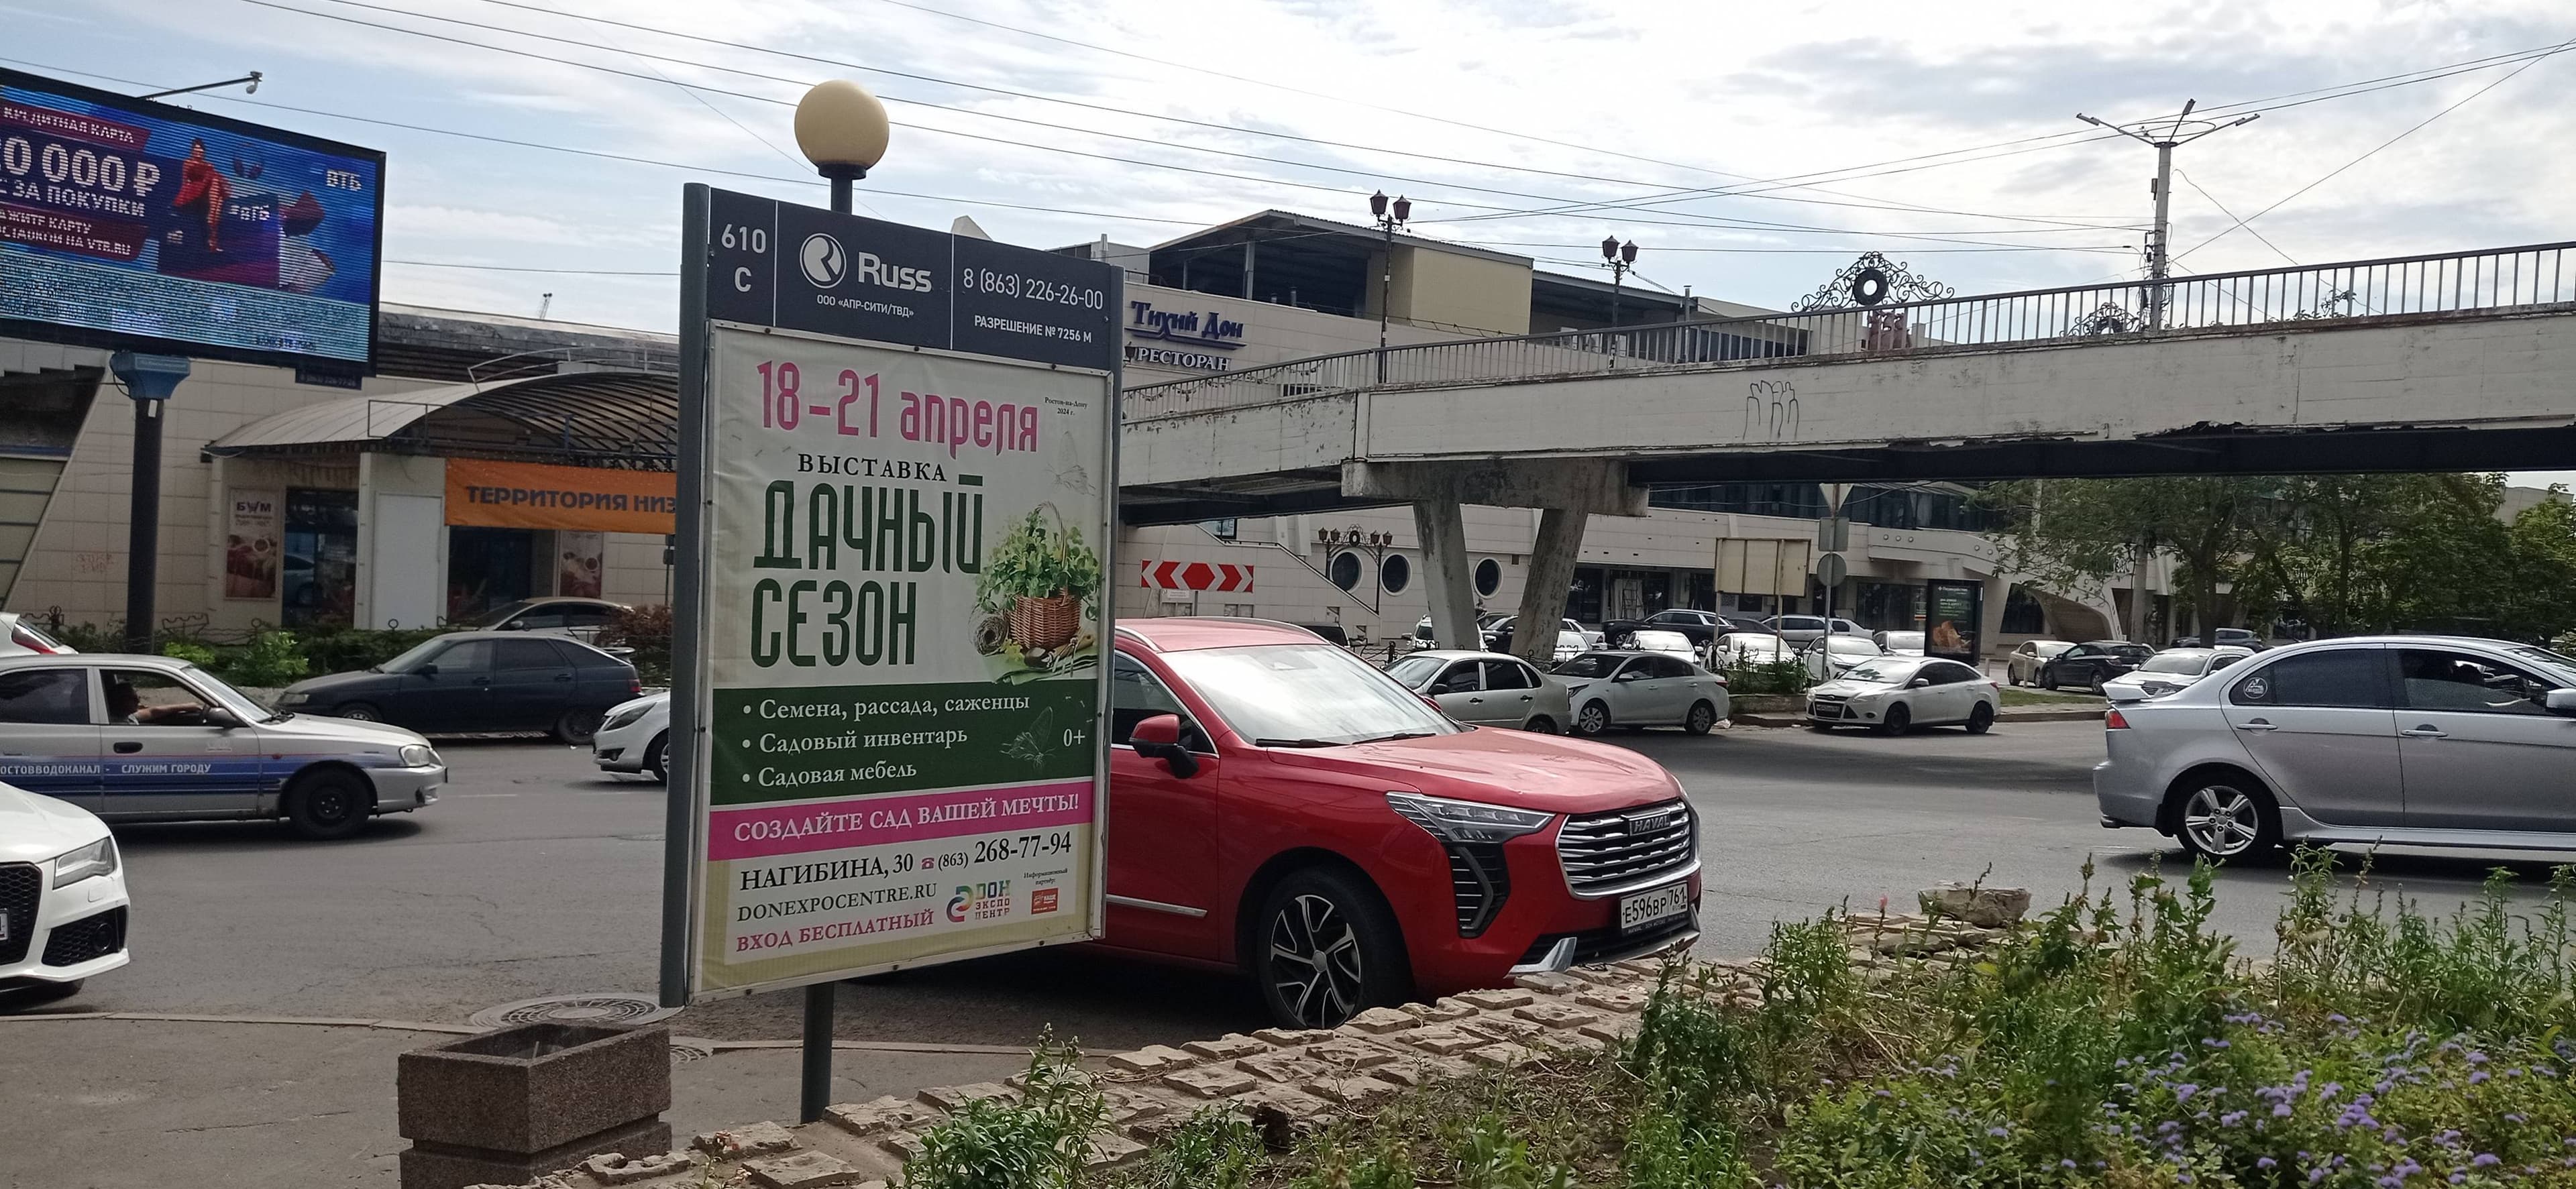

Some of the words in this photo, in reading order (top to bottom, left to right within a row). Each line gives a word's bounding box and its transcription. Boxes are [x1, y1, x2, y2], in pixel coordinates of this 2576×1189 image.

[91, 123, 134, 144] КАРТА
[42, 142, 126, 192] 000
[326, 169, 362, 192] ВТБ
[13, 179, 41, 201] ЗА
[47, 185, 145, 217] ПОКУПКИ
[48, 217, 91, 234] КАРТУ
[721, 223, 766, 254] 610
[66, 235, 84, 247] НА
[735, 266, 751, 293] С
[858, 251, 932, 292] Russ
[963, 268, 974, 288] 8
[979, 268, 1021, 297] (863)
[1026, 278, 1104, 310] 226-26-00
[816, 294, 836, 306] ООО
[838, 297, 914, 317] «АПР-СИТИ/ТВД»
[975, 315, 1042, 336] РАЗРЕШЕНИЕ
[1044, 323, 1057, 337] №
[1058, 325, 1081, 343] 7256
[1082, 331, 1092, 343] М
[1131, 300, 1199, 335] Тихий
[1201, 311, 1244, 340] Дон
[1137, 347, 1231, 372] РЕСТОРАН
[1057, 407, 1069, 415] 2024
[900, 391, 1038, 460] апреля
[798, 453, 947, 483] ВЫСТАВКА
[466, 486, 628, 512] ТЕРРИТОРИЯ
[753, 474, 983, 575] ДАЧНЫЙ
[751, 577, 917, 669] СЕЗОН
[759, 699, 847, 721] Семена,
[853, 699, 938, 722] рассада,
[945, 696, 1030, 712] саженцы
[759, 730, 857, 754] Садовый
[863, 729, 967, 750] инвентарь
[1063, 728, 1086, 747] 0+
[121, 765, 167, 774] СЛУЖИМ
[171, 764, 211, 774] ГОРОДУ
[758, 767, 845, 788] Садовая
[850, 760, 917, 781] мебель
[734, 811, 863, 842] СОЗДАЙТЕ
[869, 808, 912, 830] САД
[917, 797, 996, 824] ВАШЕЙ
[1001, 793, 1079, 816] МЕЧТЫ!
[1633, 815, 1670, 833] HAVAL
[740, 856, 889, 891] НАГИБИНА,
[893, 853, 914, 873] 30
[938, 852, 969, 872] (863)
[974, 831, 1072, 864] 268-77-94
[737, 883, 937, 922] DONEXPOCENTRE.RU
[1625, 895, 1667, 924] Е596ВР
[1669, 887, 1686, 906] 761
[737, 929, 794, 952] ВХОД
[798, 909, 934, 944] БЕСПЛАТНЫЙ
